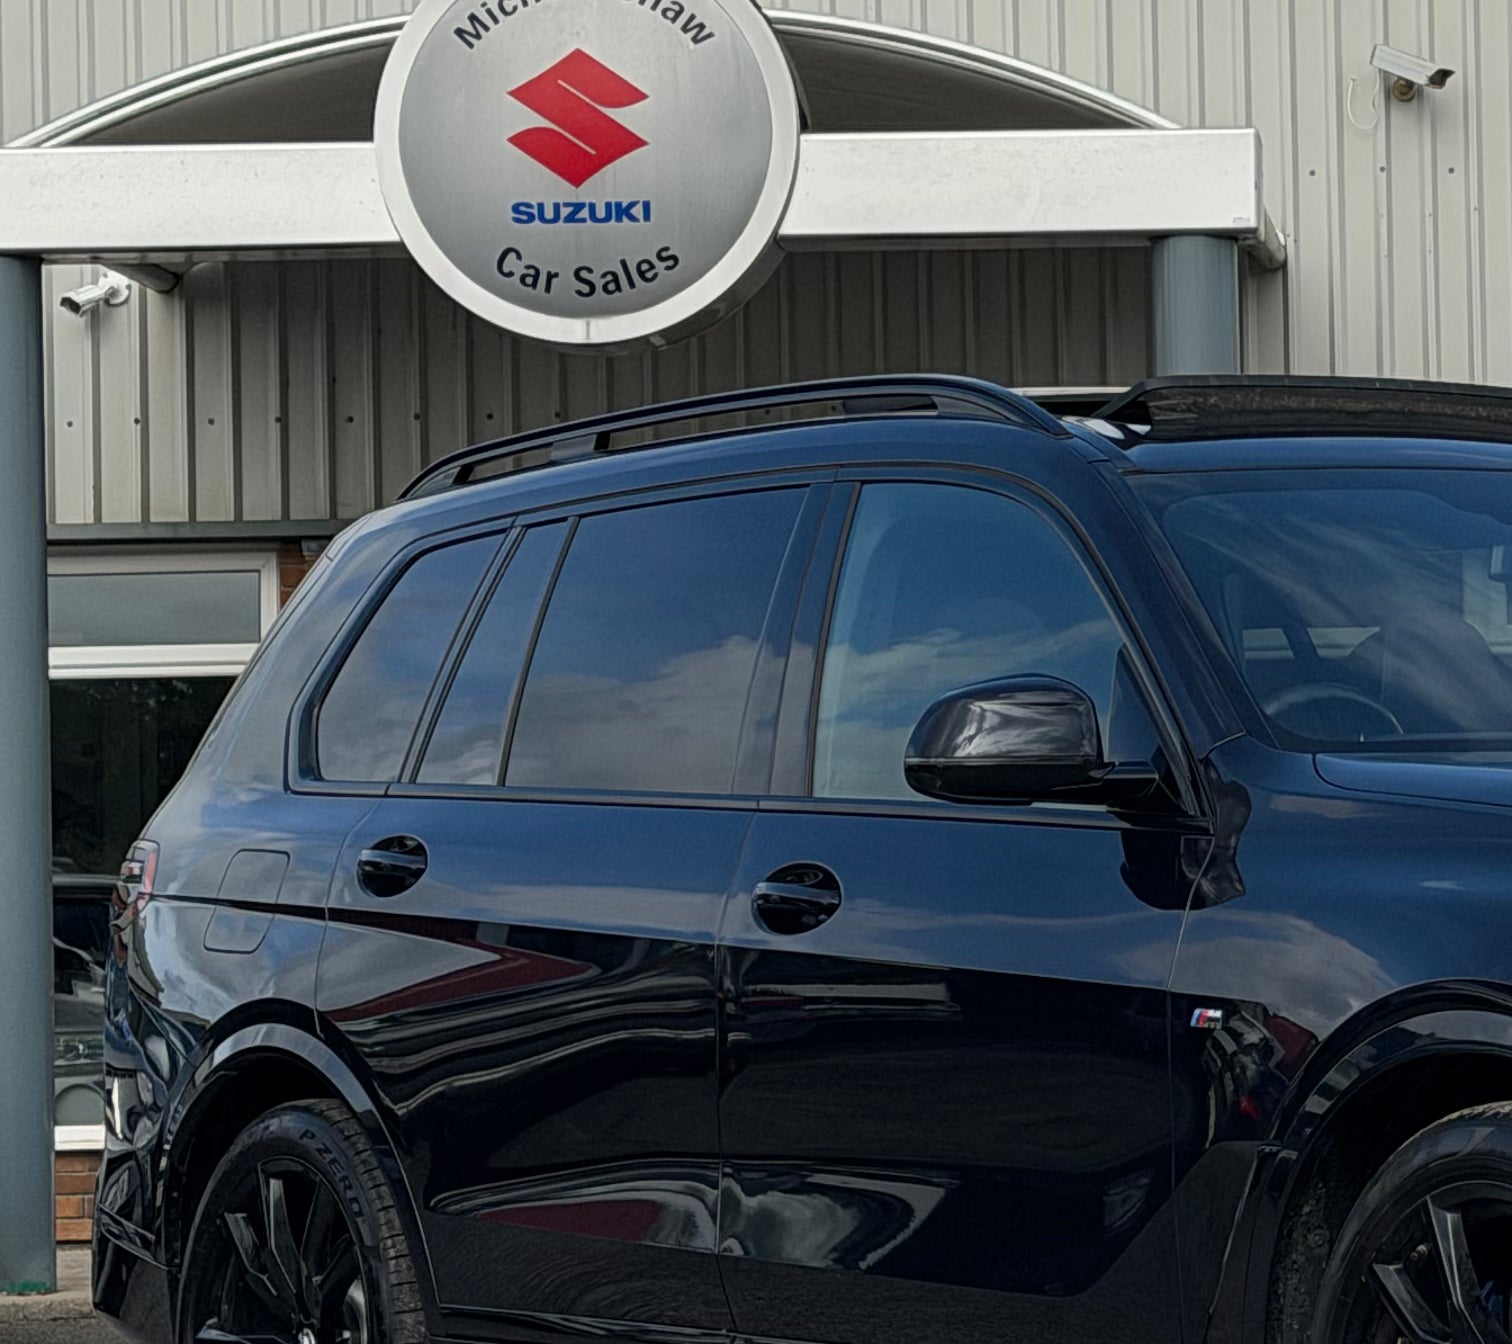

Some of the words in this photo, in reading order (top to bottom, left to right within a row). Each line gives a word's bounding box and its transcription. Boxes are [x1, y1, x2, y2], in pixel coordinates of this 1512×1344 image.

[510, 199, 652, 225] SUZUKI
[495, 246, 560, 295] Car
[573, 245, 681, 298] Sales
